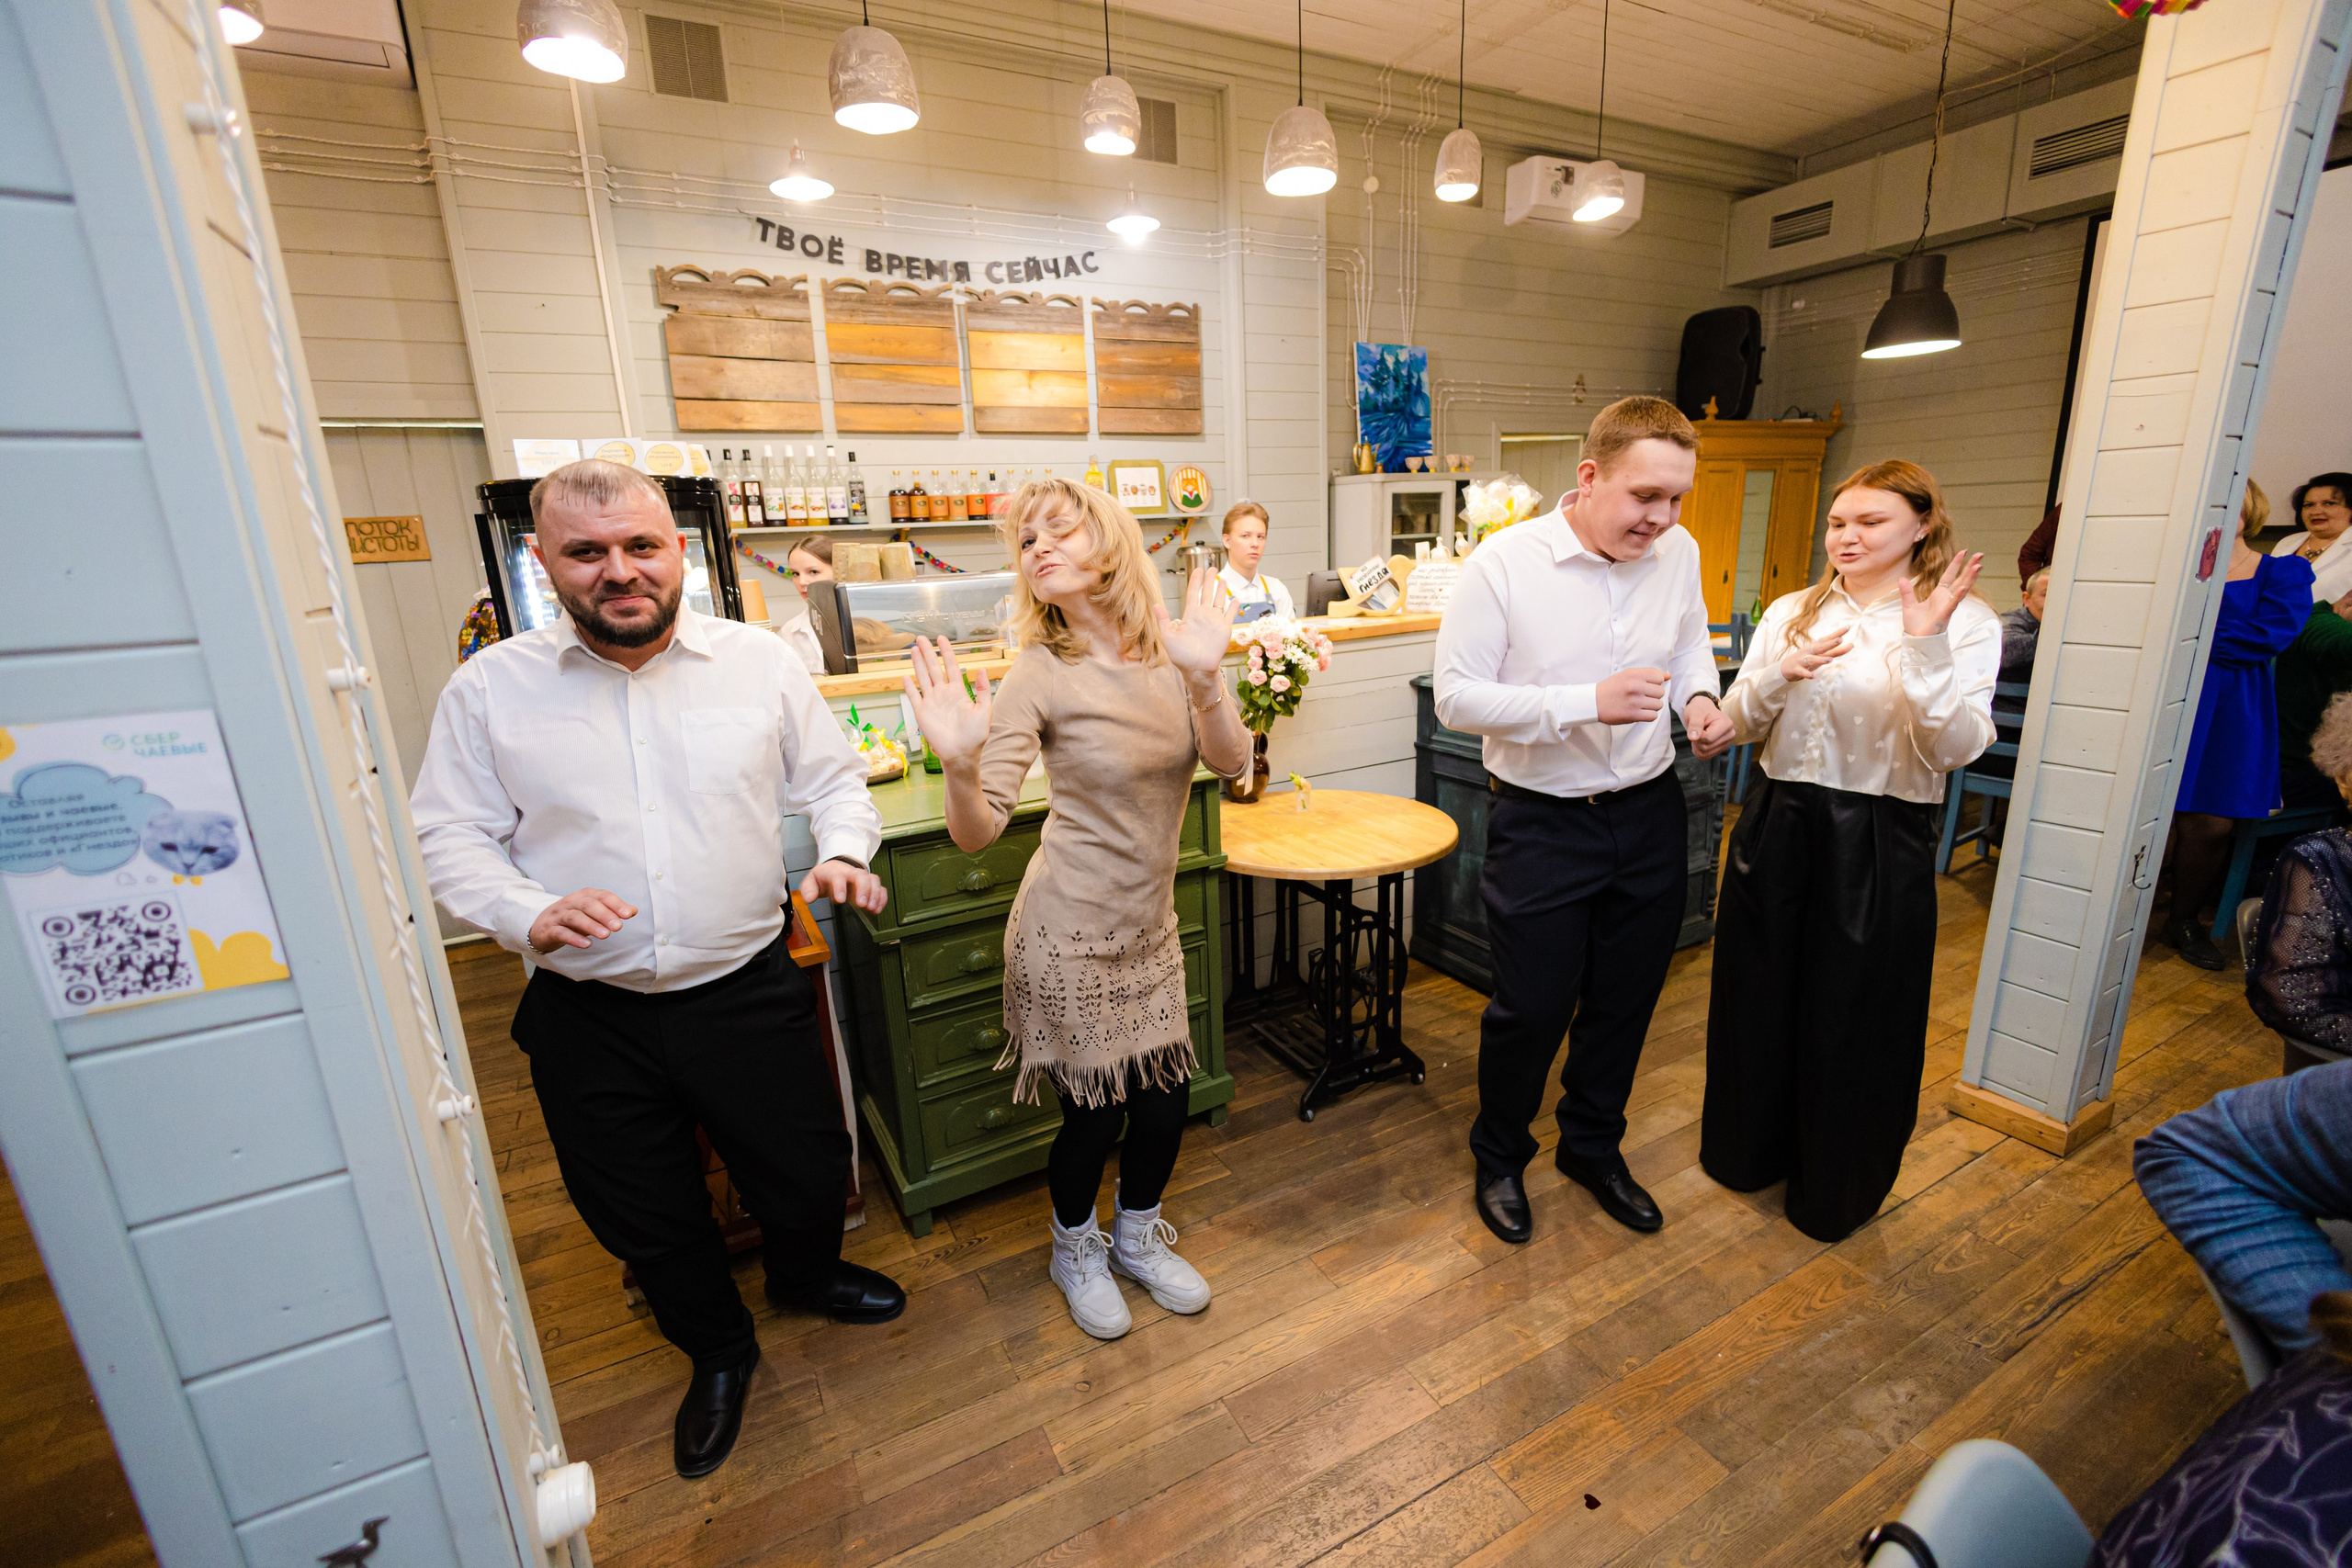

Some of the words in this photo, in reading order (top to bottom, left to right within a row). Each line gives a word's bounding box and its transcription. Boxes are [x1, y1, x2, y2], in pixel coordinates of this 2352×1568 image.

[756, 217, 844, 265] ТВОЁ
[865, 248, 971, 283] ВРЕМЯ
[985, 251, 1100, 284] СЕЙЧАС
[345, 520, 413, 536] ПОТОК
[130, 732, 180, 746] СБЕР
[133, 742, 208, 758] ЧАЕВЫЕ
